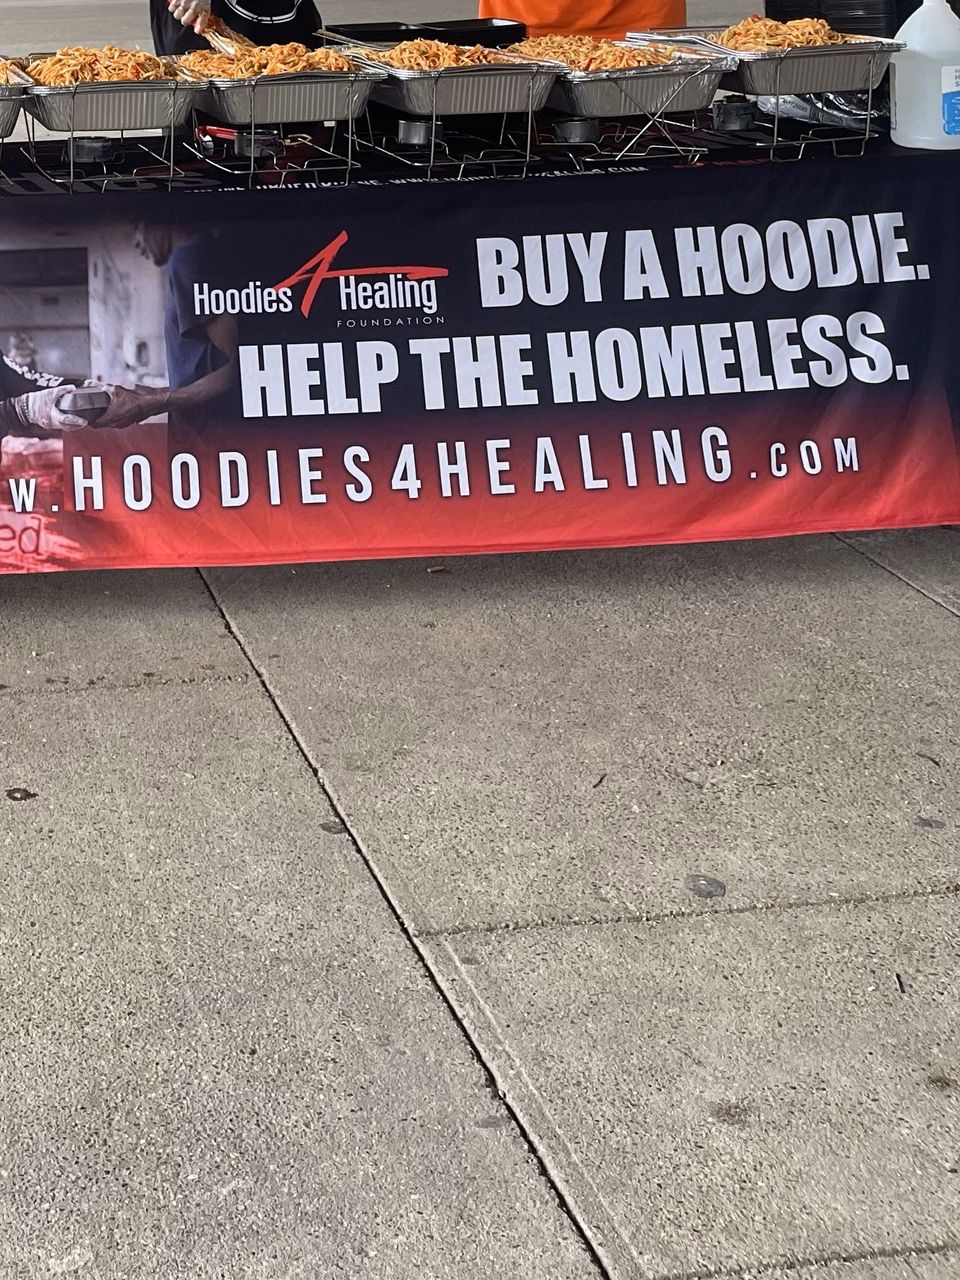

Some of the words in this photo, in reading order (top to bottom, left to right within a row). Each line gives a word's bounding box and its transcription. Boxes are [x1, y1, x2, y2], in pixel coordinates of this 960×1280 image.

[273, 230, 450, 319] 4
[475, 232, 609, 308] BUY
[624, 229, 670, 301] A
[674, 211, 931, 297] HOODIE.
[193, 281, 293, 316] Hoodies
[336, 316, 446, 328] FOUNDATION
[339, 274, 438, 315] Healing
[238, 340, 400, 419] HELP
[408, 333, 540, 411] THE
[546, 310, 911, 404] HOMELESS.
